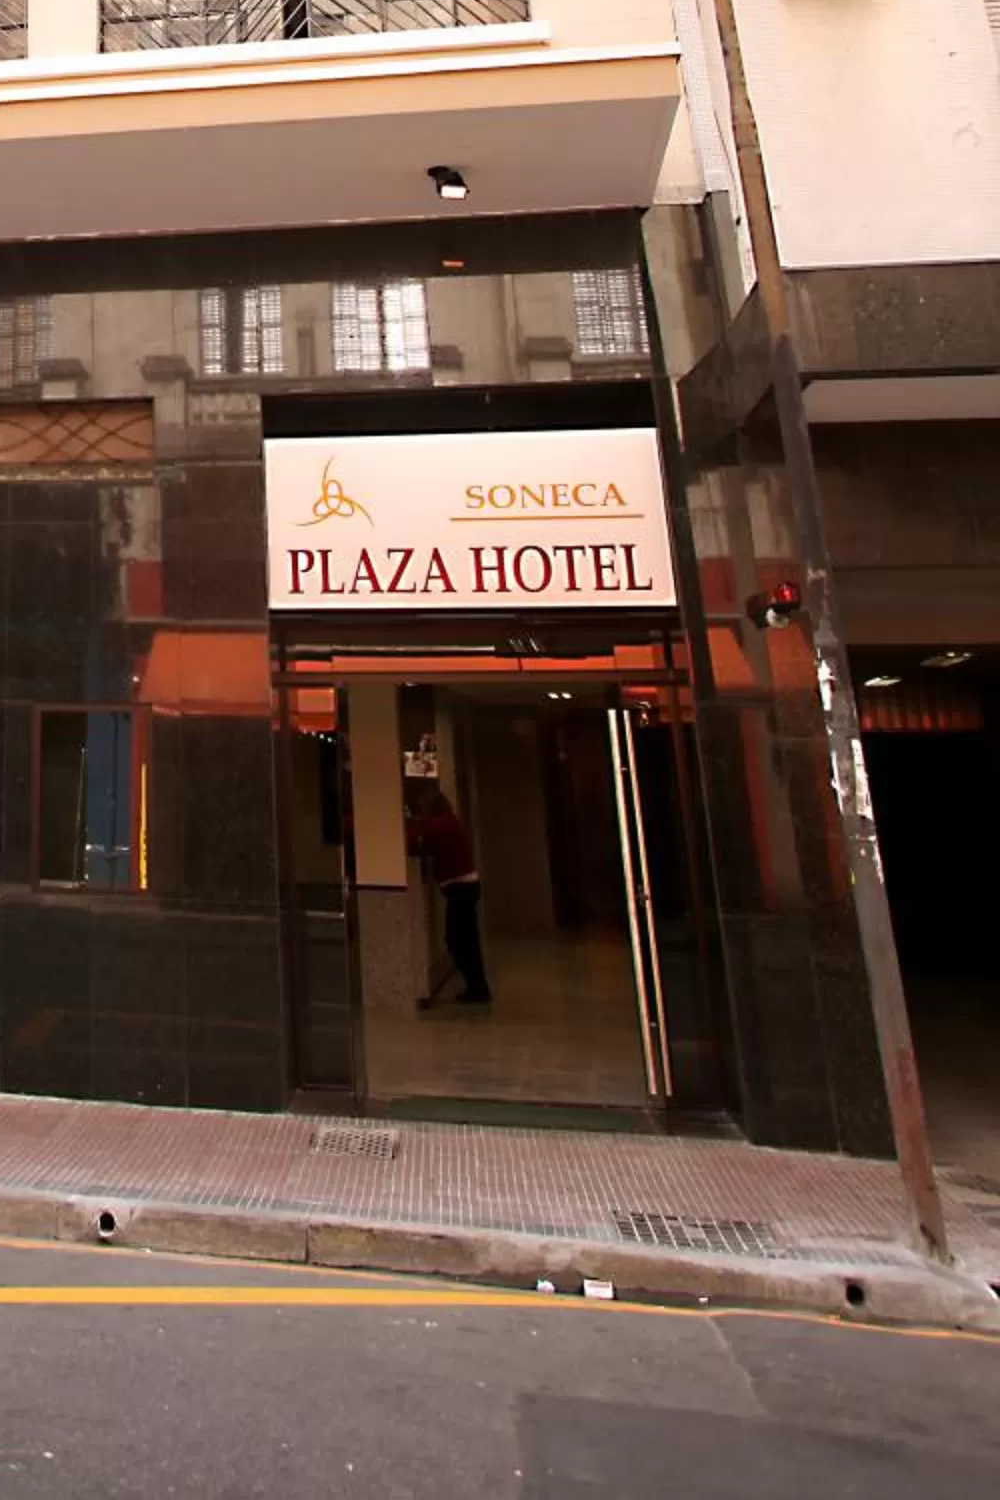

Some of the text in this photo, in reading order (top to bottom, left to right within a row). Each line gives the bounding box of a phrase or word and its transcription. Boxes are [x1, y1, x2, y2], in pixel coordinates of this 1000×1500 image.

[465, 482, 627, 509] SONECA
[287, 543, 653, 595] PLAZA HOTEL
